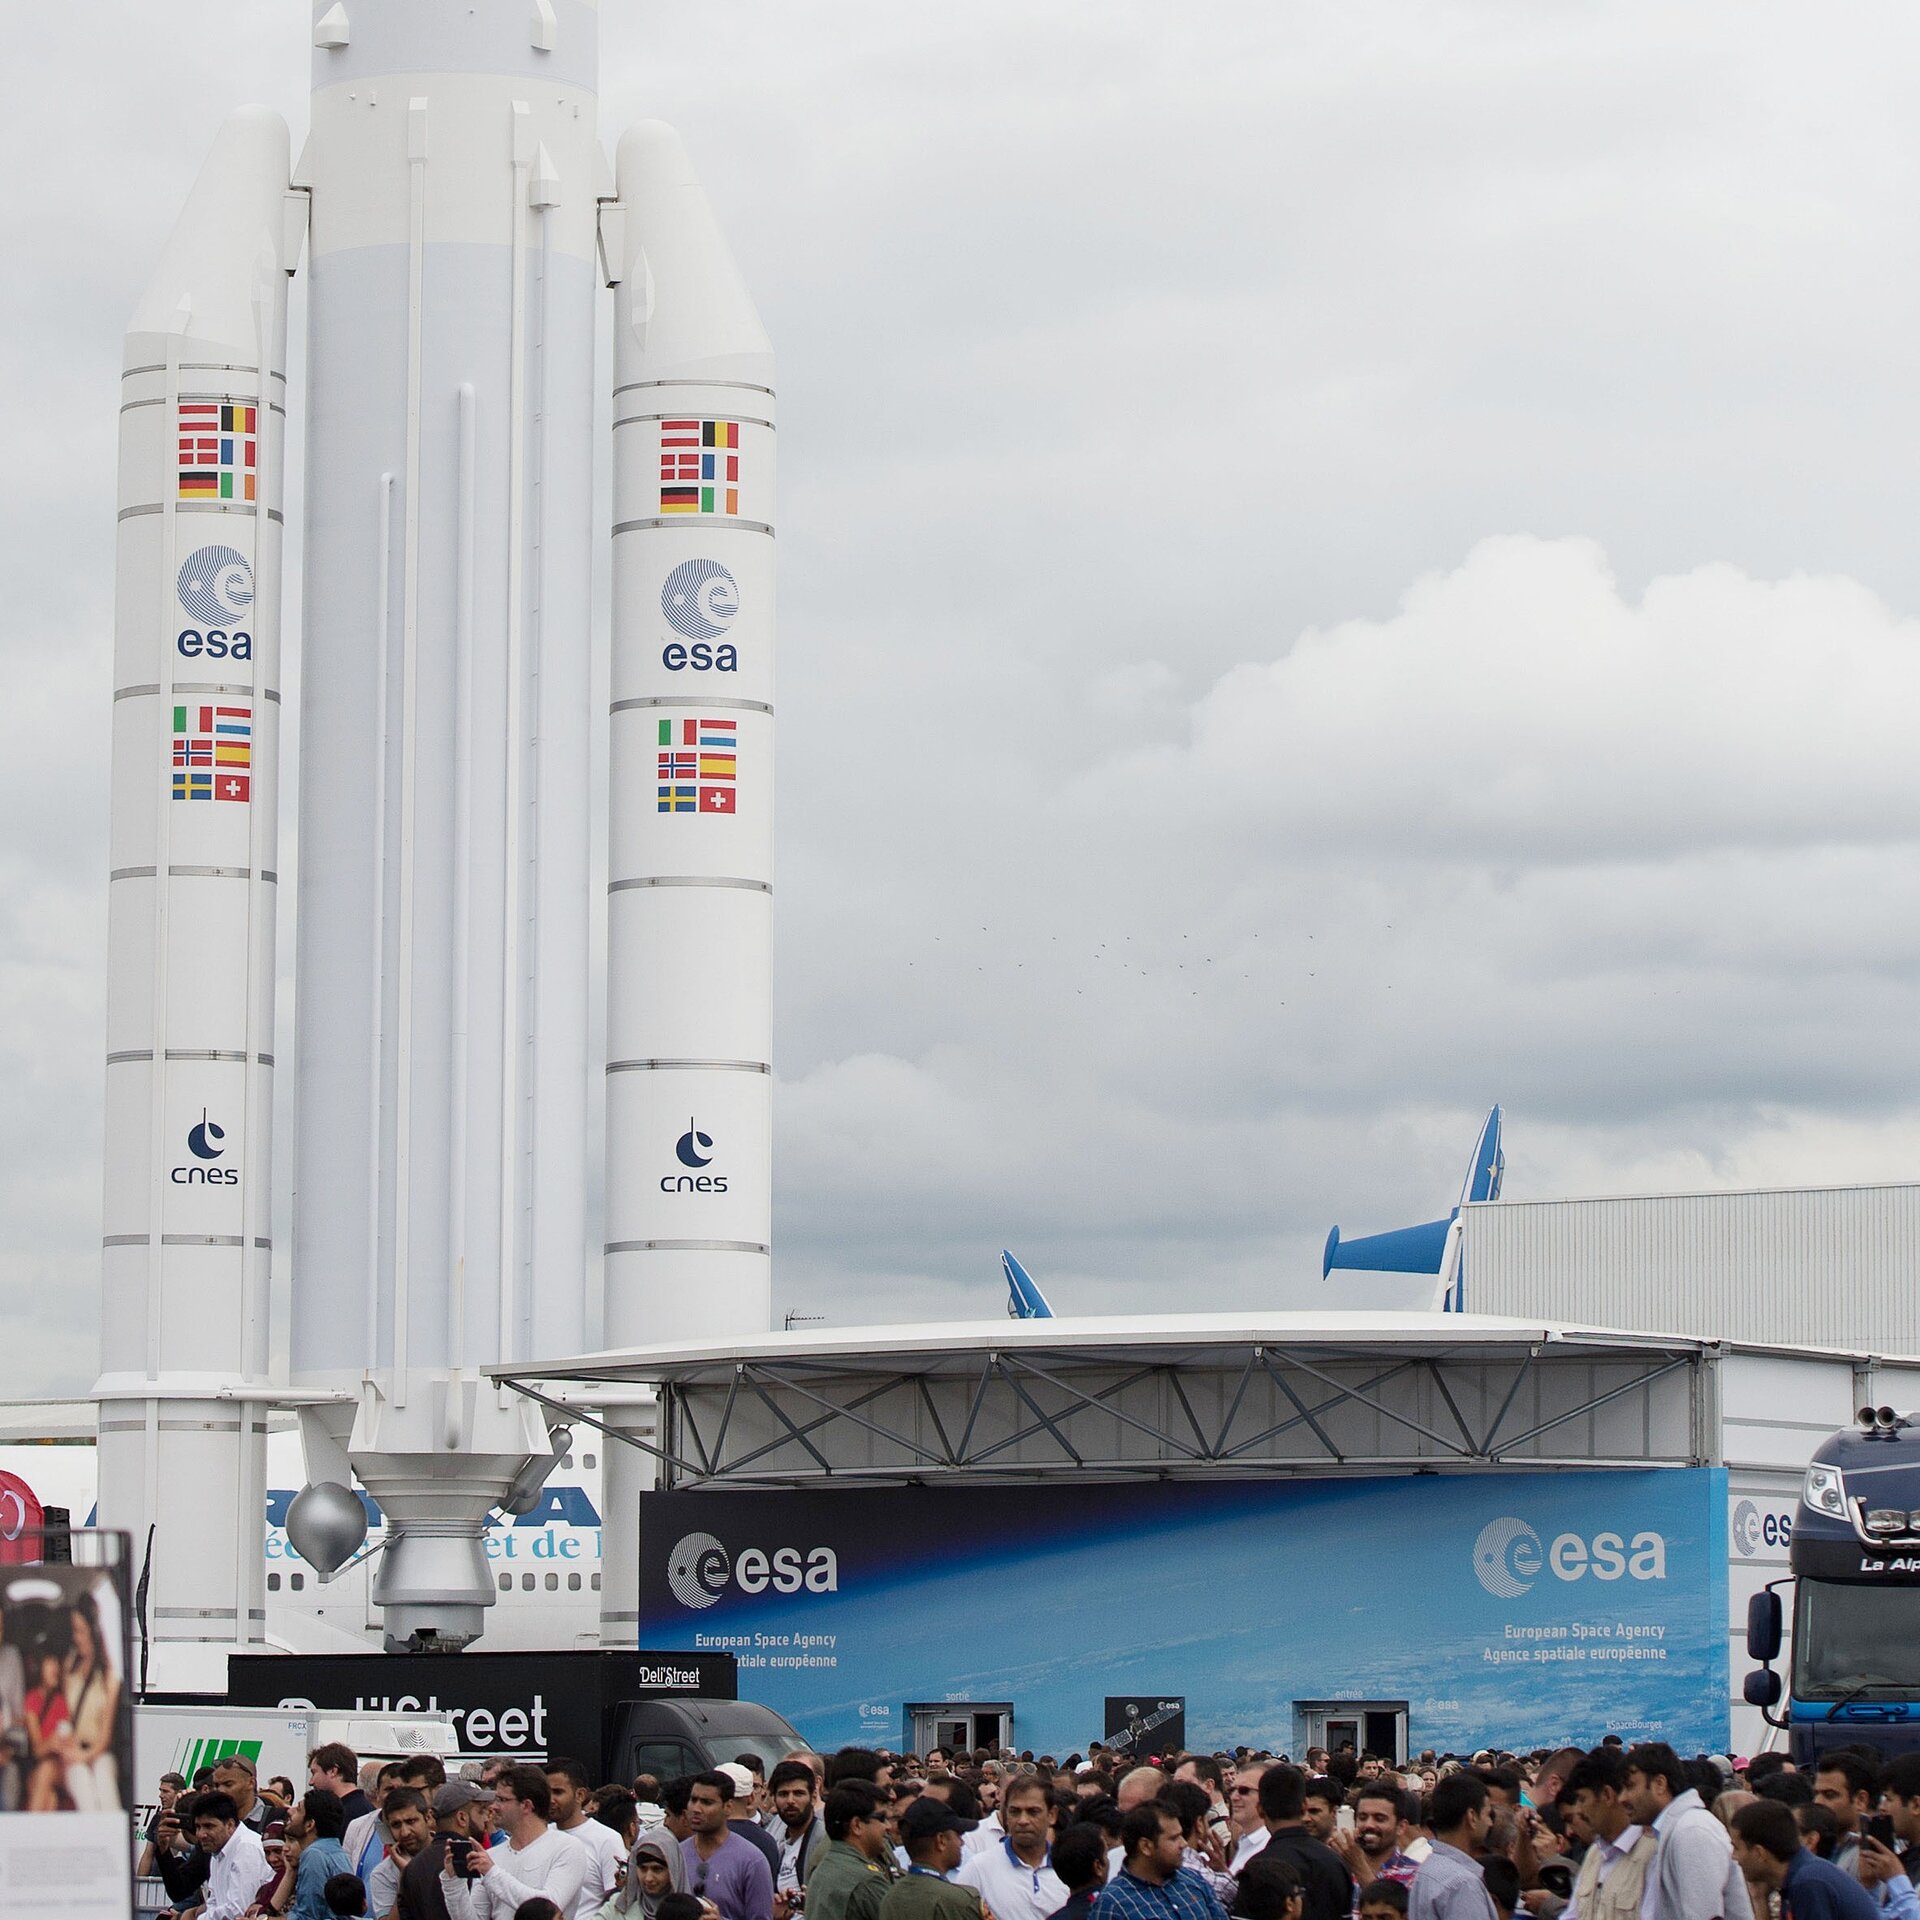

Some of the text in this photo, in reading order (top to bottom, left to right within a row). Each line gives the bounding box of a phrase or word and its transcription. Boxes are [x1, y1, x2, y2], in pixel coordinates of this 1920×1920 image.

[177, 629, 252, 661] esa
[662, 643, 738, 672] esa
[171, 1167, 239, 1185] cnes
[660, 1175, 728, 1193] cnes
[1762, 1513, 1792, 1548] es
[482, 1533, 518, 1559] et
[532, 1529, 581, 1559] de
[1549, 1531, 1667, 1582] esa
[1861, 1557, 1920, 1573] La Alp
[735, 1546, 838, 1594] esa
[695, 1632, 837, 1649] European Space Agency
[1505, 1622, 1666, 1641] European Space Agency
[770, 1653, 838, 1670] européenne
[1483, 1644, 1667, 1664] Agence spatiale européenne
[639, 1666, 700, 1687] Deli'Street
[945, 1690, 970, 1701] sortie
[1335, 1689, 1364, 1699] entrée
[870, 1704, 890, 1715] esa
[1437, 1700, 1459, 1710] esa
[1606, 1719, 1663, 1731] #SpaceBourget
